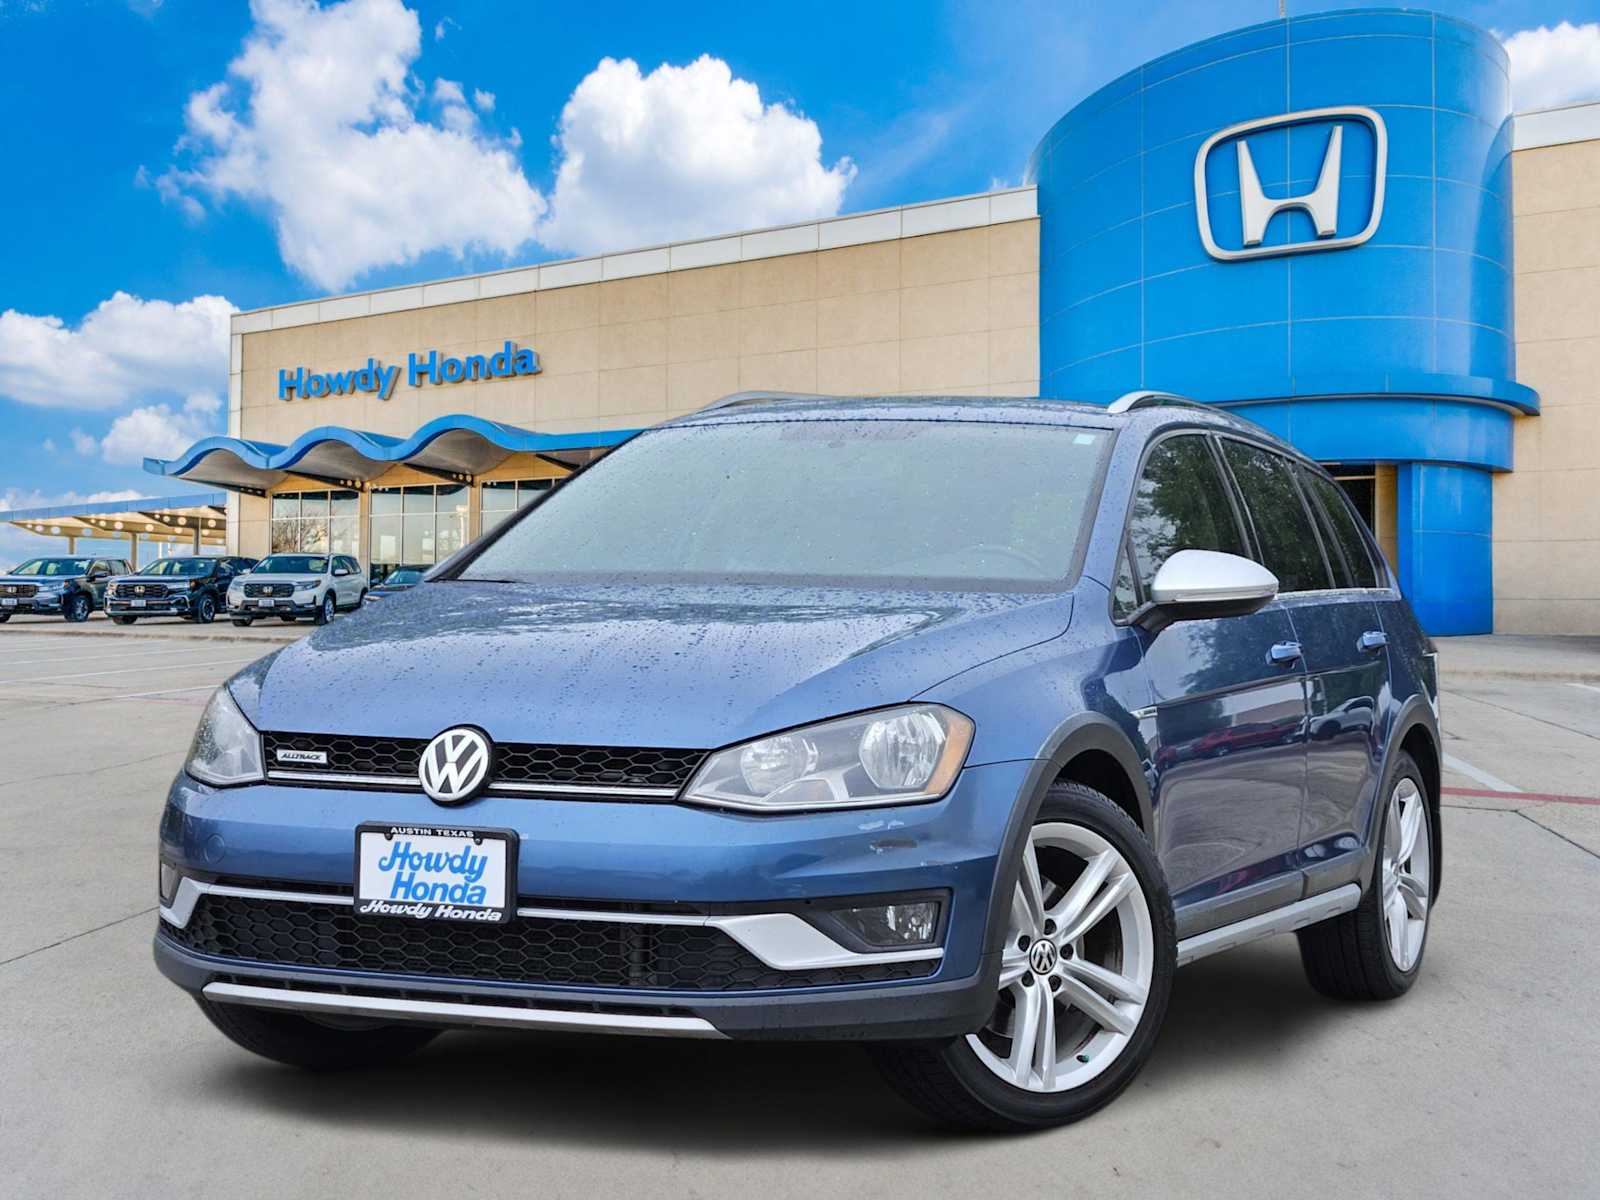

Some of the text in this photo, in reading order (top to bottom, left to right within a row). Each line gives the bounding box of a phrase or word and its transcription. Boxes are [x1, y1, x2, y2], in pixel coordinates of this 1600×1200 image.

[278, 340, 542, 401] Howdy Honda
[390, 826, 475, 838] AUSTIN TEXAS
[378, 841, 488, 883] Howdy
[390, 871, 487, 904] Honda
[359, 900, 502, 922] Howdy Honda
